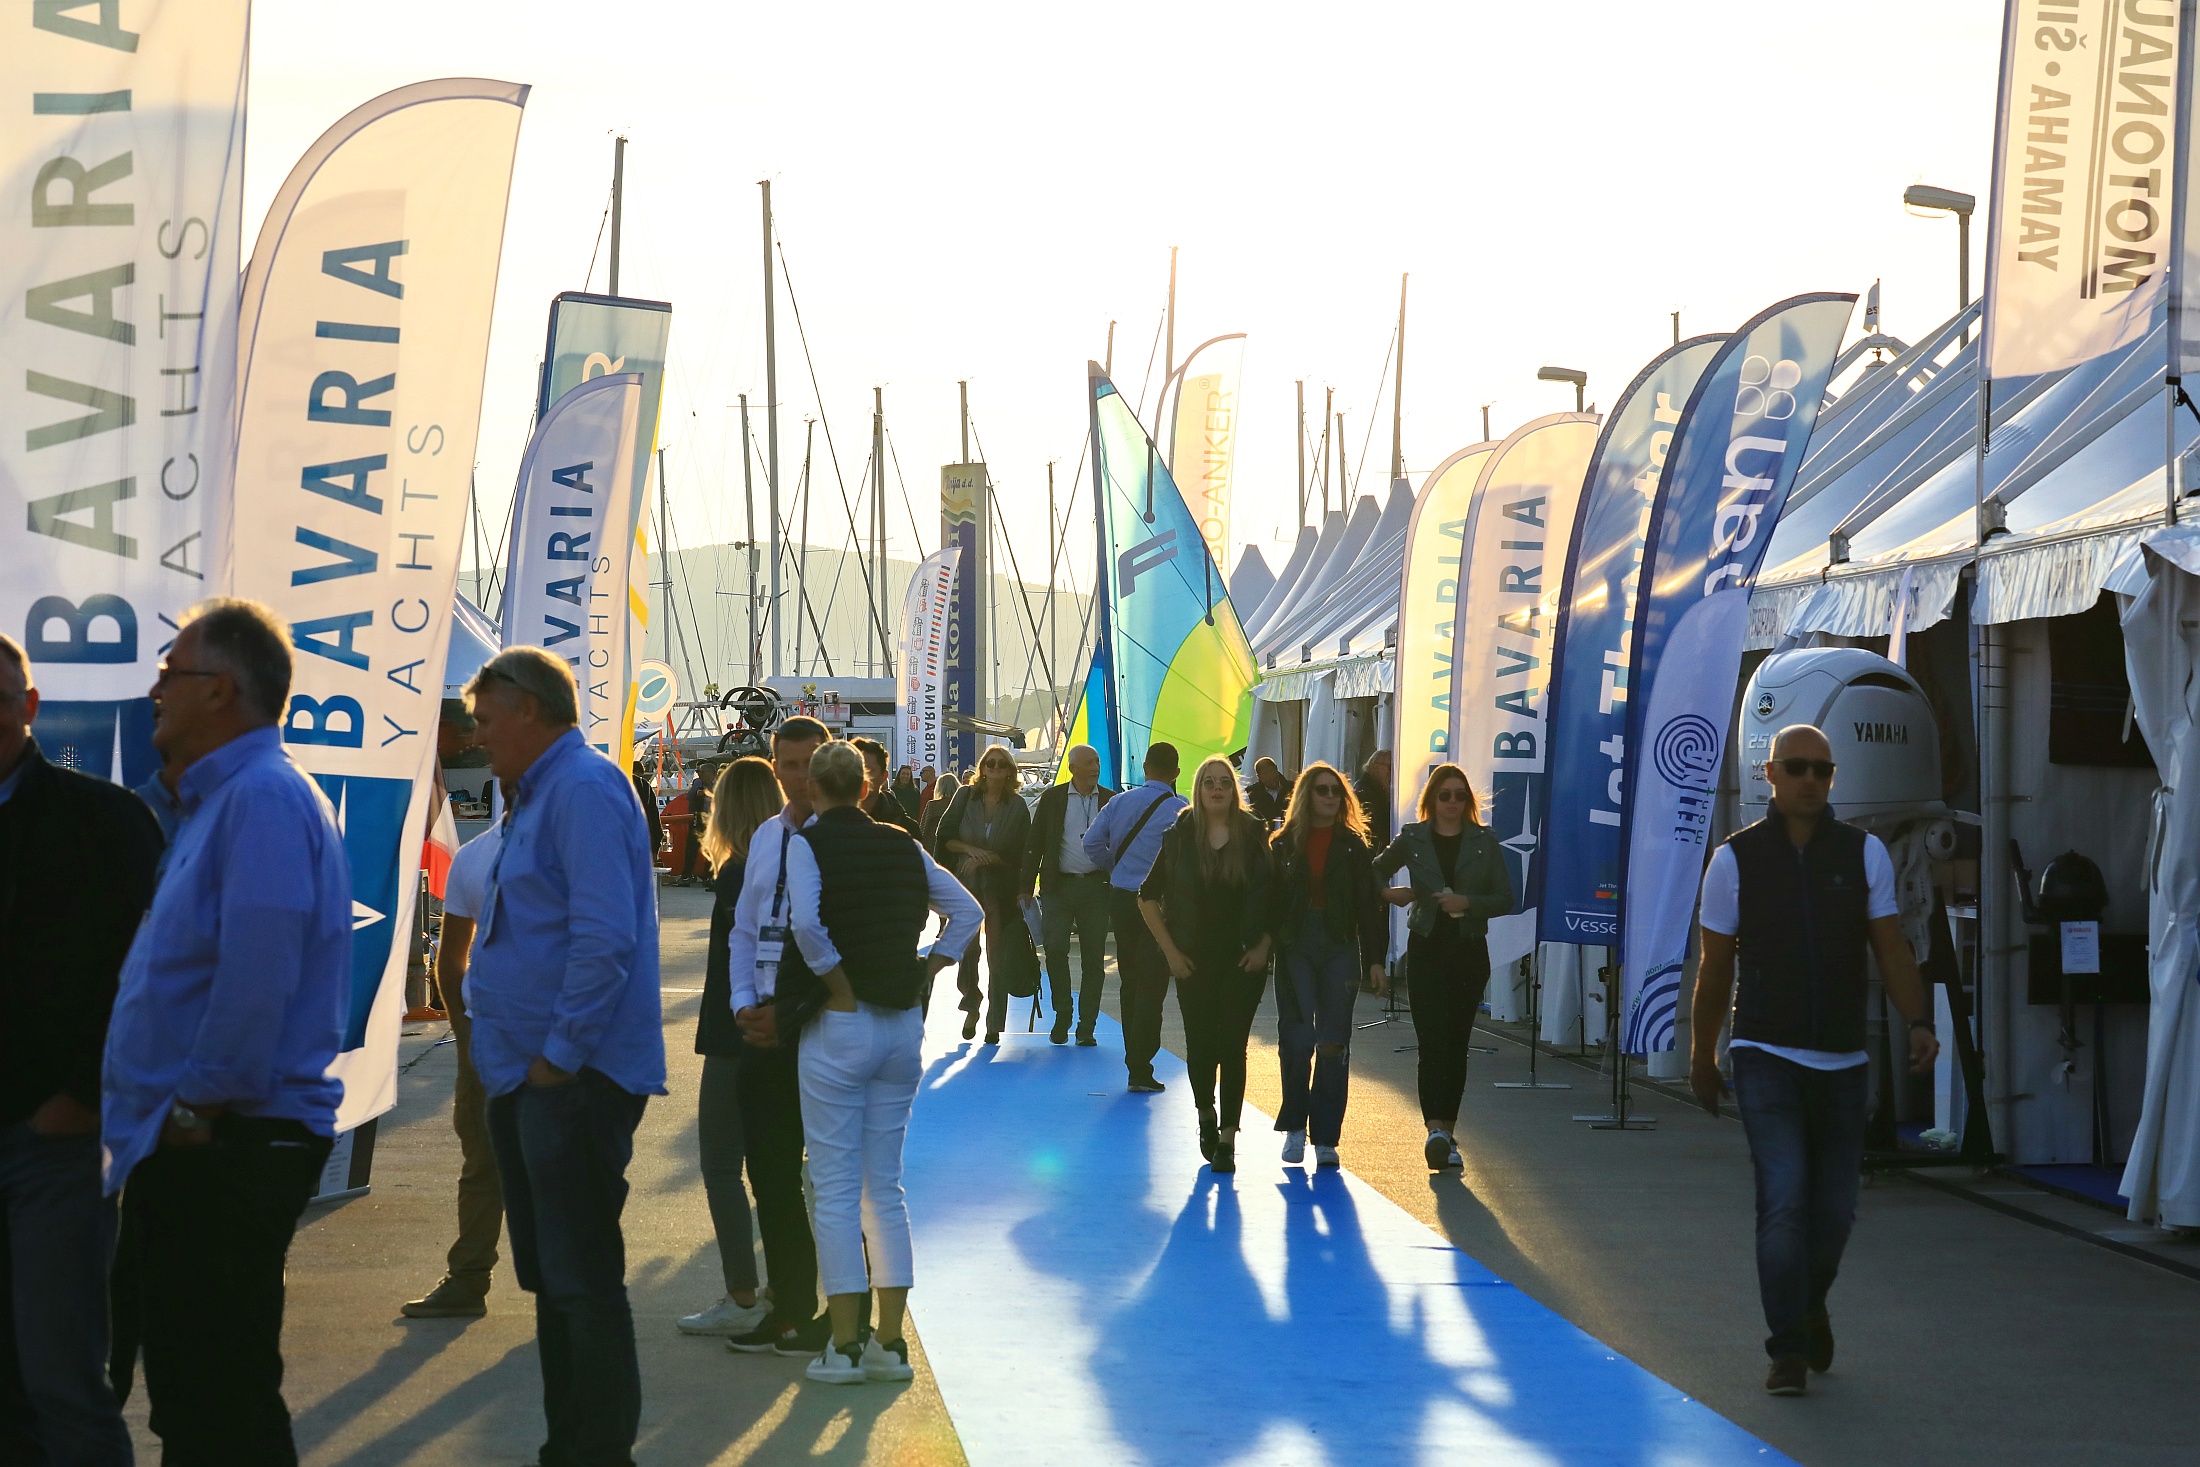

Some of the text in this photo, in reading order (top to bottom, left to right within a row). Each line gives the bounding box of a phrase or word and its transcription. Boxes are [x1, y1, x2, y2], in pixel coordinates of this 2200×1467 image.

[25, 0, 140, 664] BAVARIA
[285, 239, 410, 749] BAVARIA
[381, 424, 445, 749] YACHTS
[544, 461, 593, 690] VARIA
[589, 556, 610, 729] YACHTS
[1494, 495, 1547, 759] BAVARIA
[1748, 733, 1771, 750] 25
[1853, 722, 1908, 745] YAMAHA
